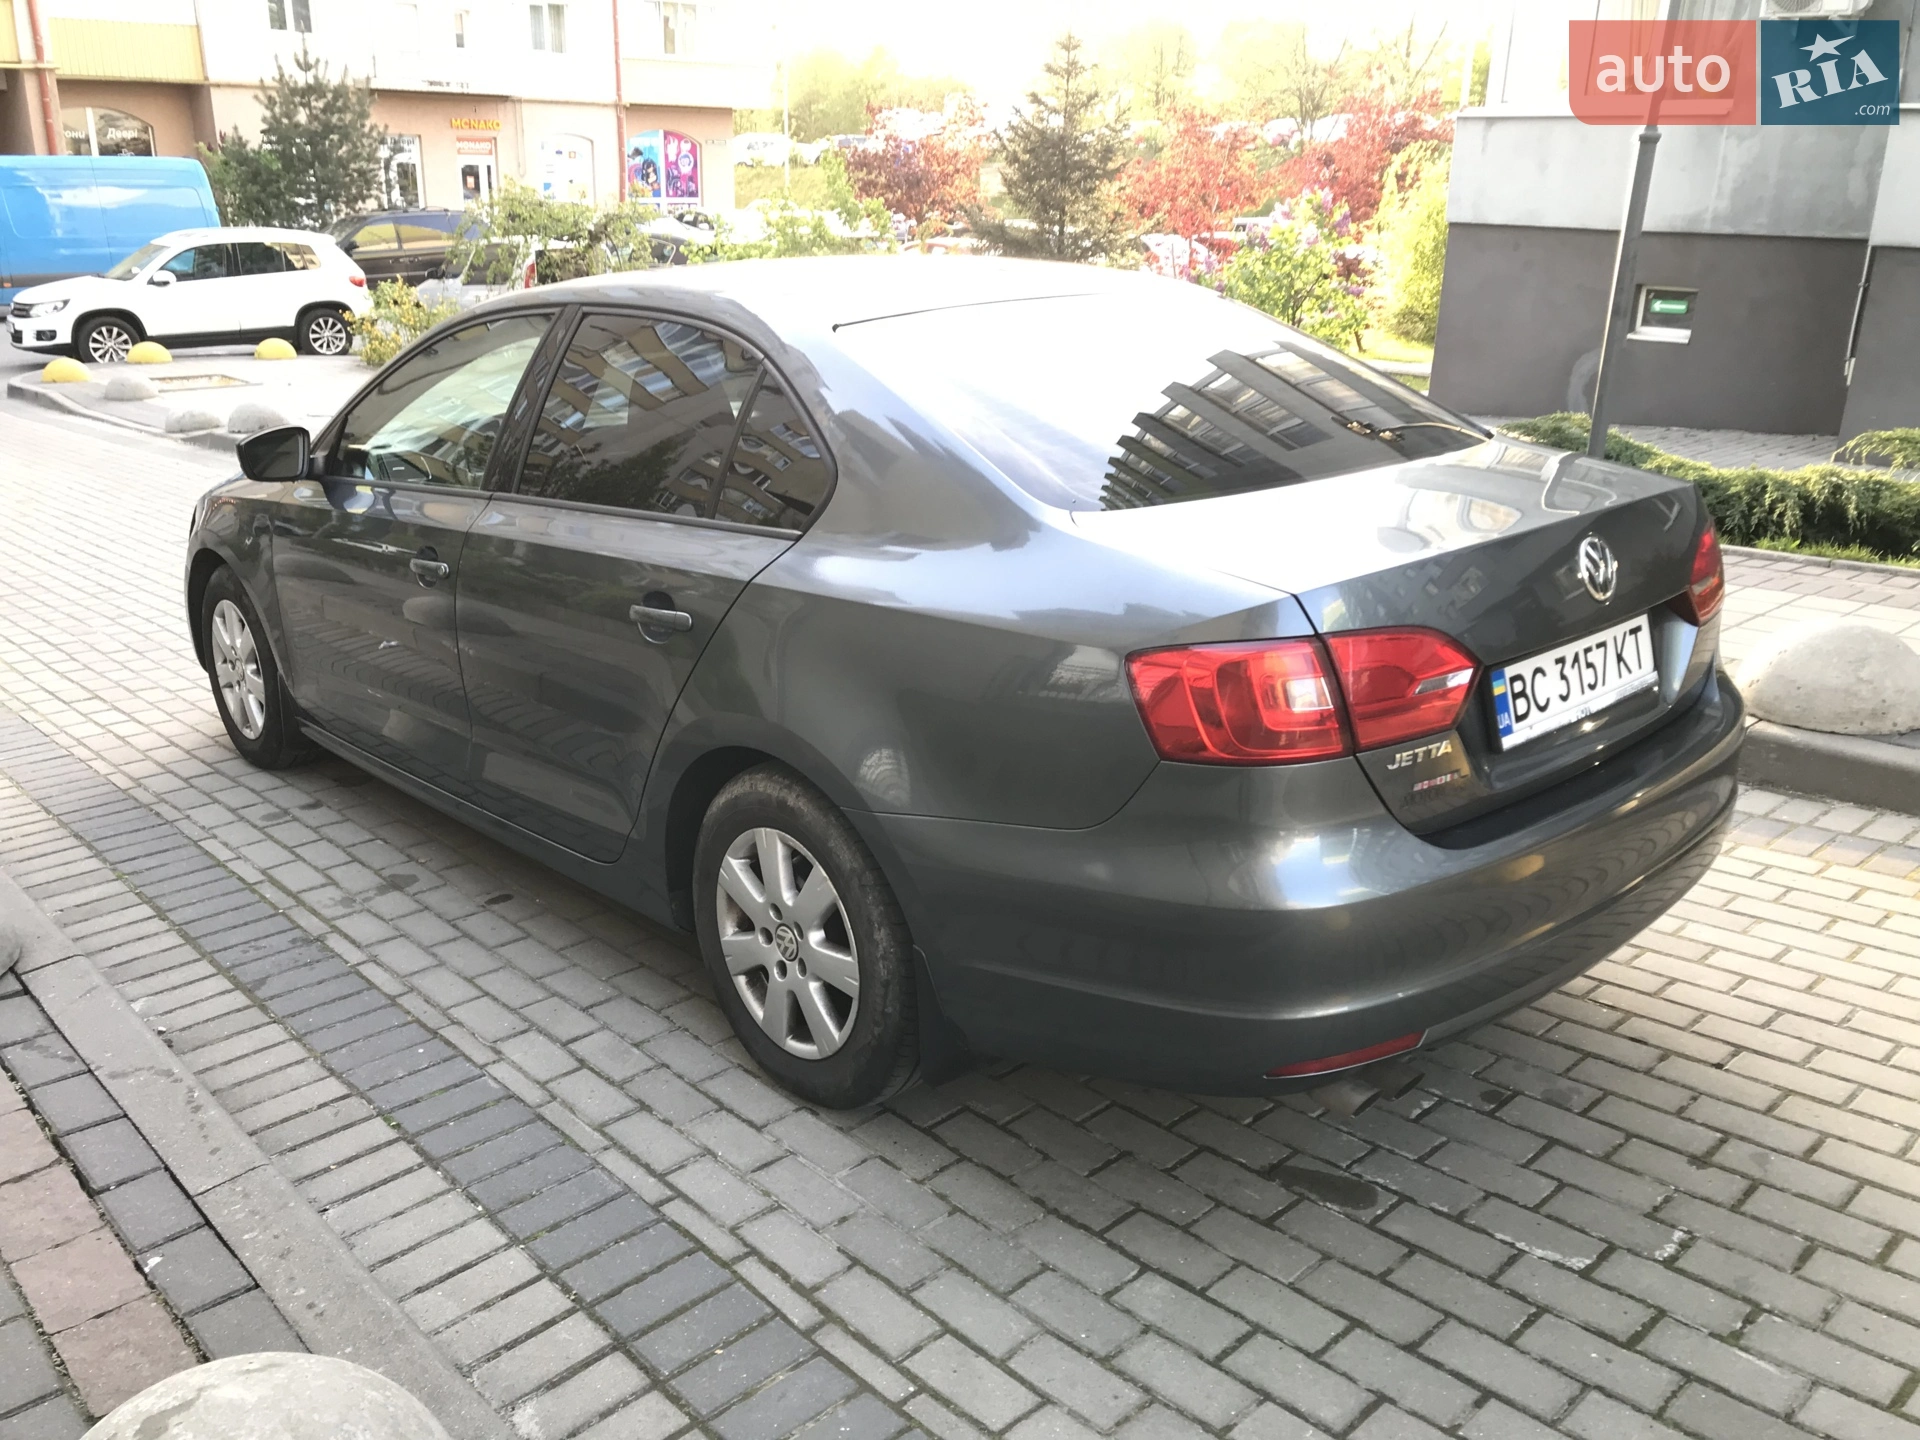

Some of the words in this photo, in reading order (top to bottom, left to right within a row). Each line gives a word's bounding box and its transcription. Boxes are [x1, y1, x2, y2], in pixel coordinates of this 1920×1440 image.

[1509, 666, 1550, 724] BC
[1555, 640, 1607, 702] 3157
[1613, 625, 1643, 679] KT
[1497, 711, 1512, 729] UA
[1386, 740, 1453, 770] JETTA
